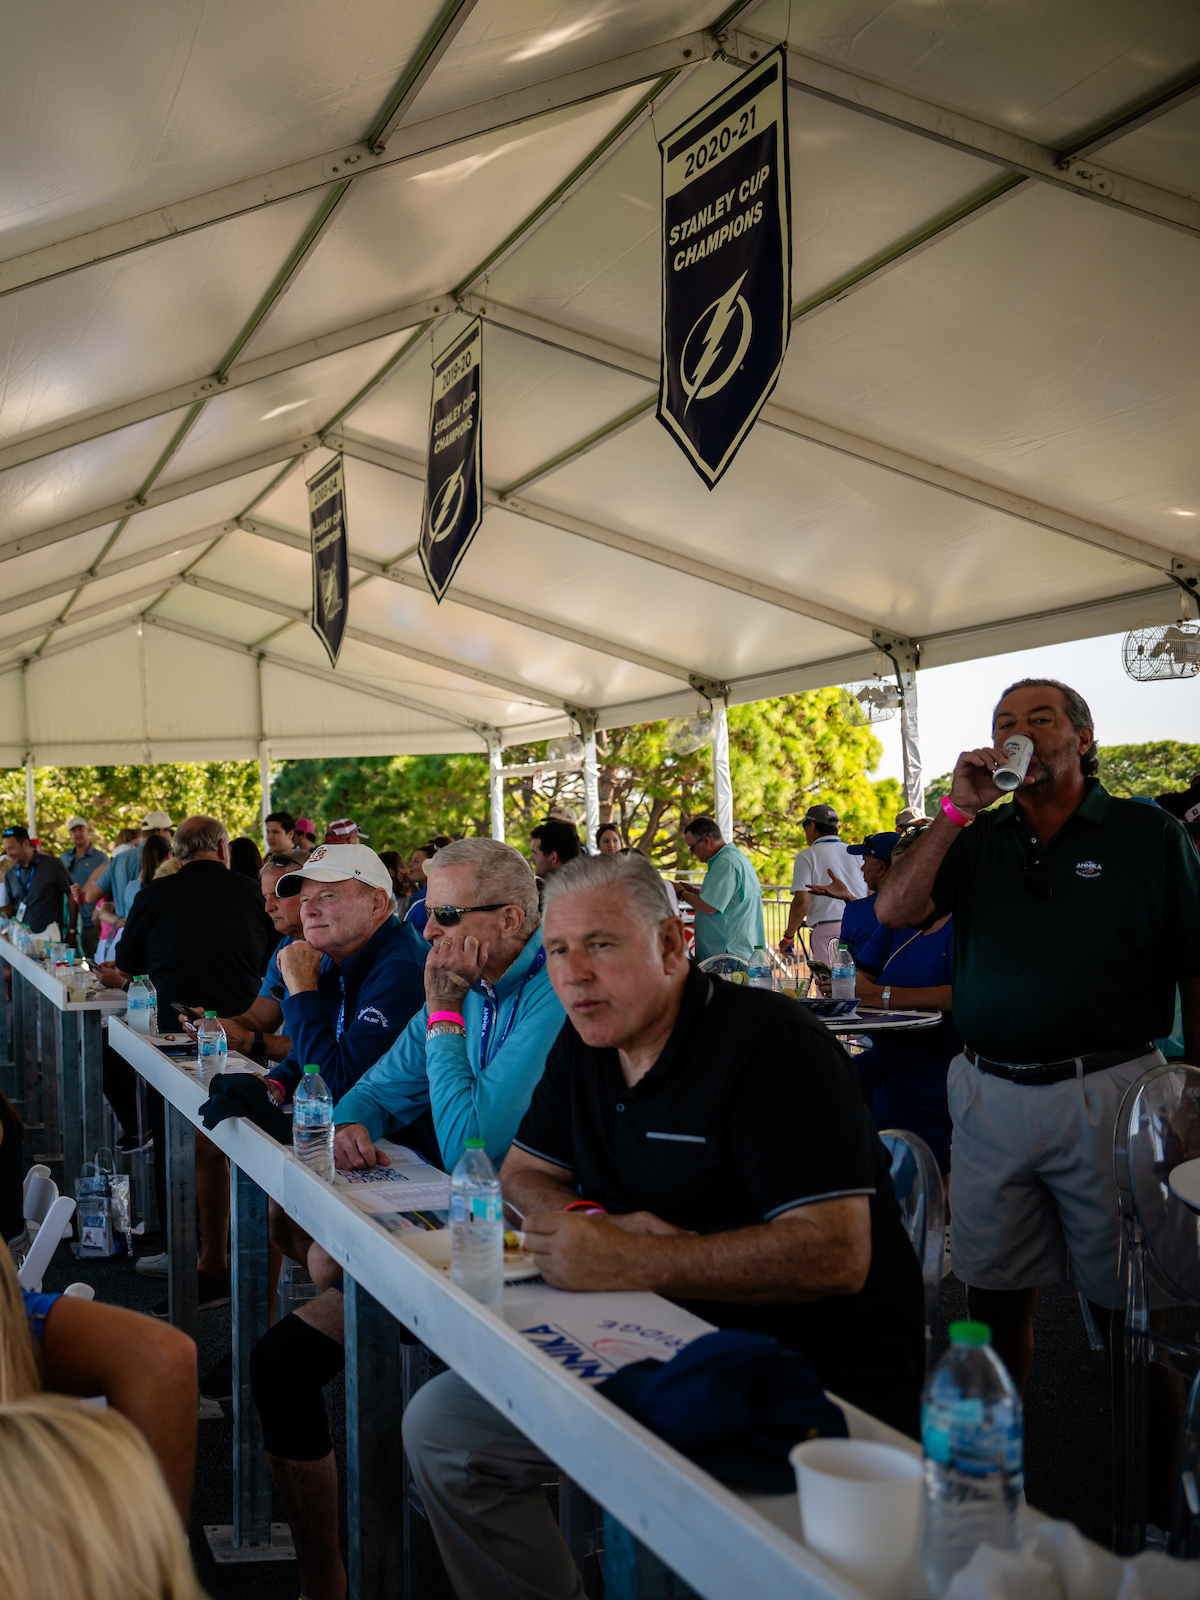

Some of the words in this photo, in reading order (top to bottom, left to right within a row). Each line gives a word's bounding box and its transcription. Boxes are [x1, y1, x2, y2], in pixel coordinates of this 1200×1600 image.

[684, 104, 756, 179] 2020-21
[669, 188, 736, 246] STANLEY
[738, 164, 771, 203] CUP
[673, 200, 764, 272] CHAMPIONS
[442, 351, 472, 391] 2019-20
[433, 403, 462, 436] STANLEY
[462, 391, 477, 414] CUP
[433, 414, 473, 454] CHAMPIONS
[312, 515, 333, 539] STANLEY
[332, 509, 342, 526] CUP
[315, 527, 342, 553] CHAMPIONS
[481, 1006, 490, 1038] ANNIKA
